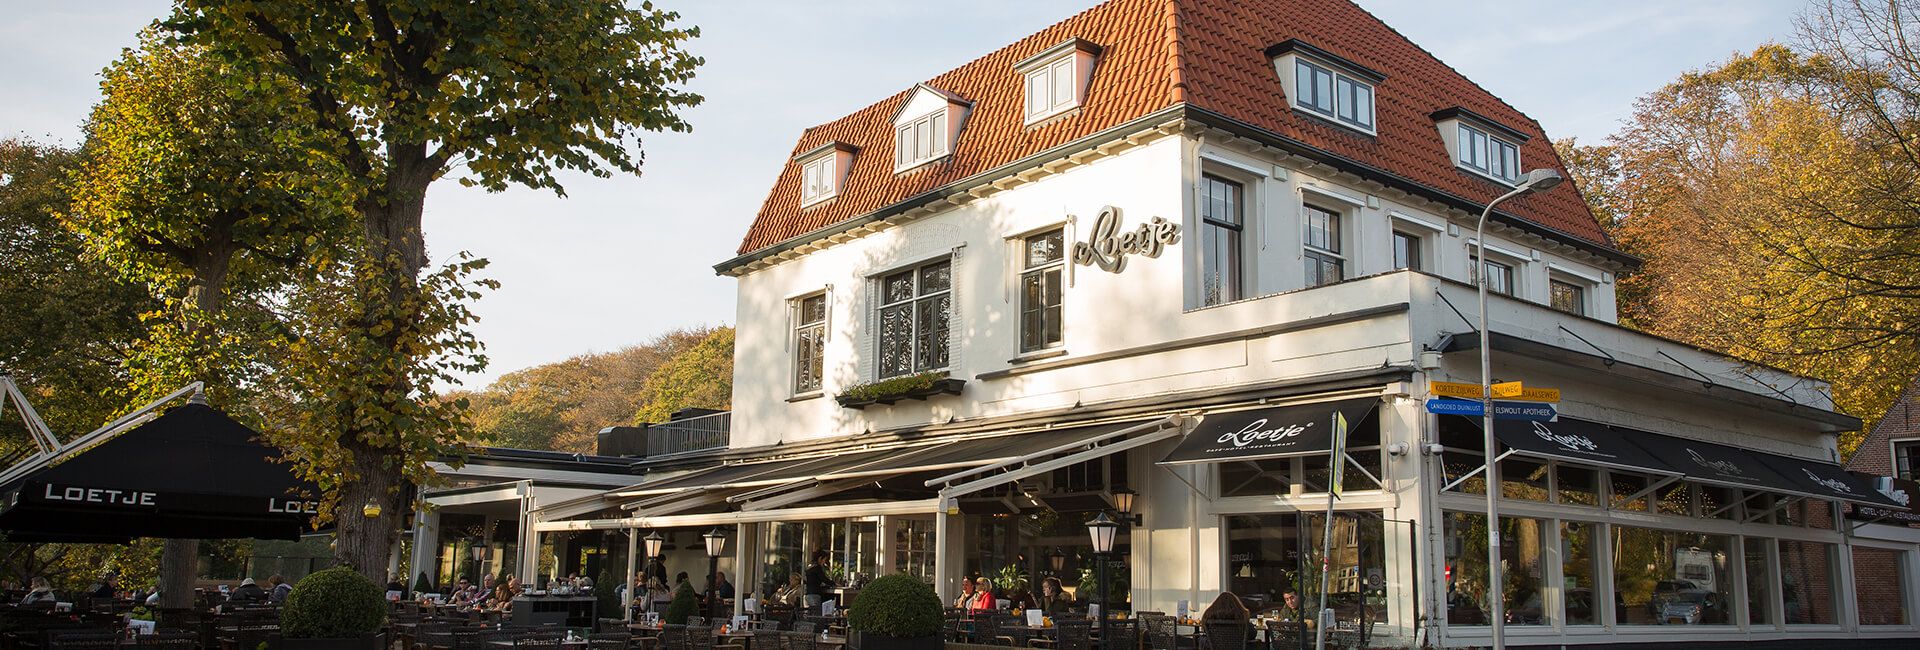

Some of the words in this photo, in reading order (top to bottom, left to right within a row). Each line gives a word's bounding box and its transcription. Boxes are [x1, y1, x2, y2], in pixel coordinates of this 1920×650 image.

[1073, 204, 1182, 274] Loetje
[1434, 385, 1455, 394] KORTE
[1523, 390, 1558, 399] DAALSEWEG
[1495, 406, 1521, 415] ELSWOUT
[1522, 407, 1551, 416] APOTHEEK
[1216, 418, 1305, 447] Loetje
[45, 483, 157, 505] LOETJE
[268, 497, 318, 514] LOE
